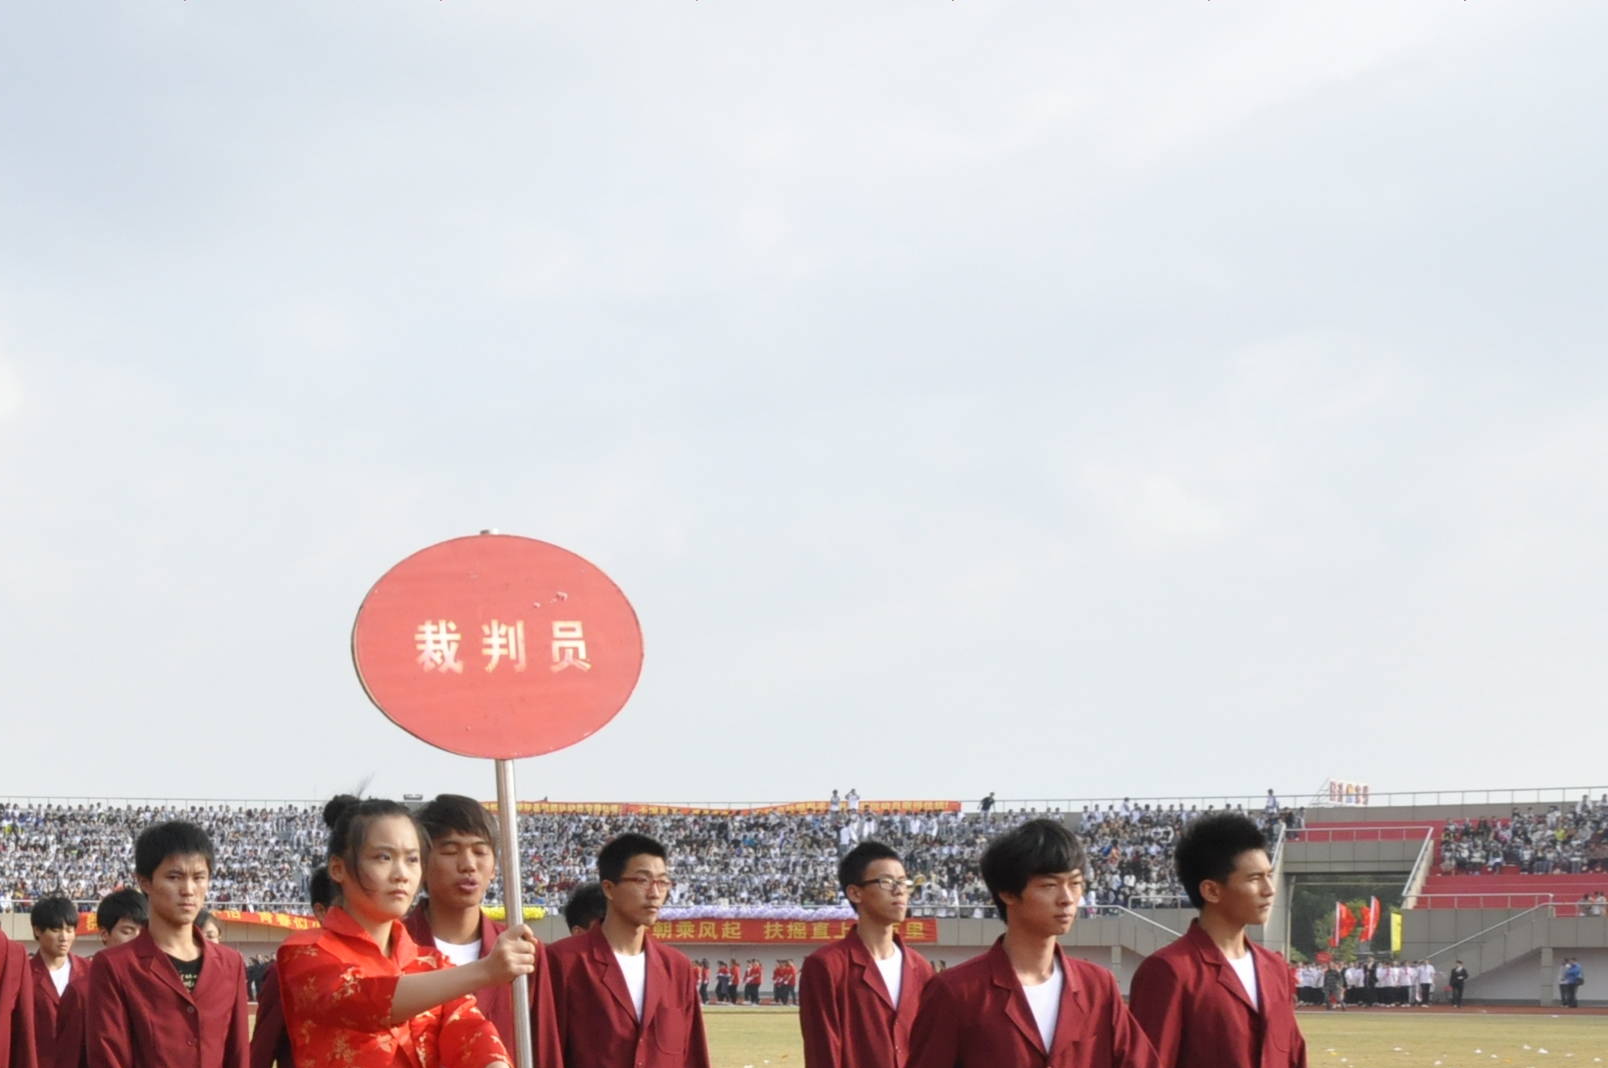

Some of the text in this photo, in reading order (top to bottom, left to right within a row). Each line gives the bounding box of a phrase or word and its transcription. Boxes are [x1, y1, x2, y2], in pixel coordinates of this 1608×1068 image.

[414, 619, 592, 674] 裁判员
[645, 921, 926, 940] 朝乘风起 扶摇直上里
